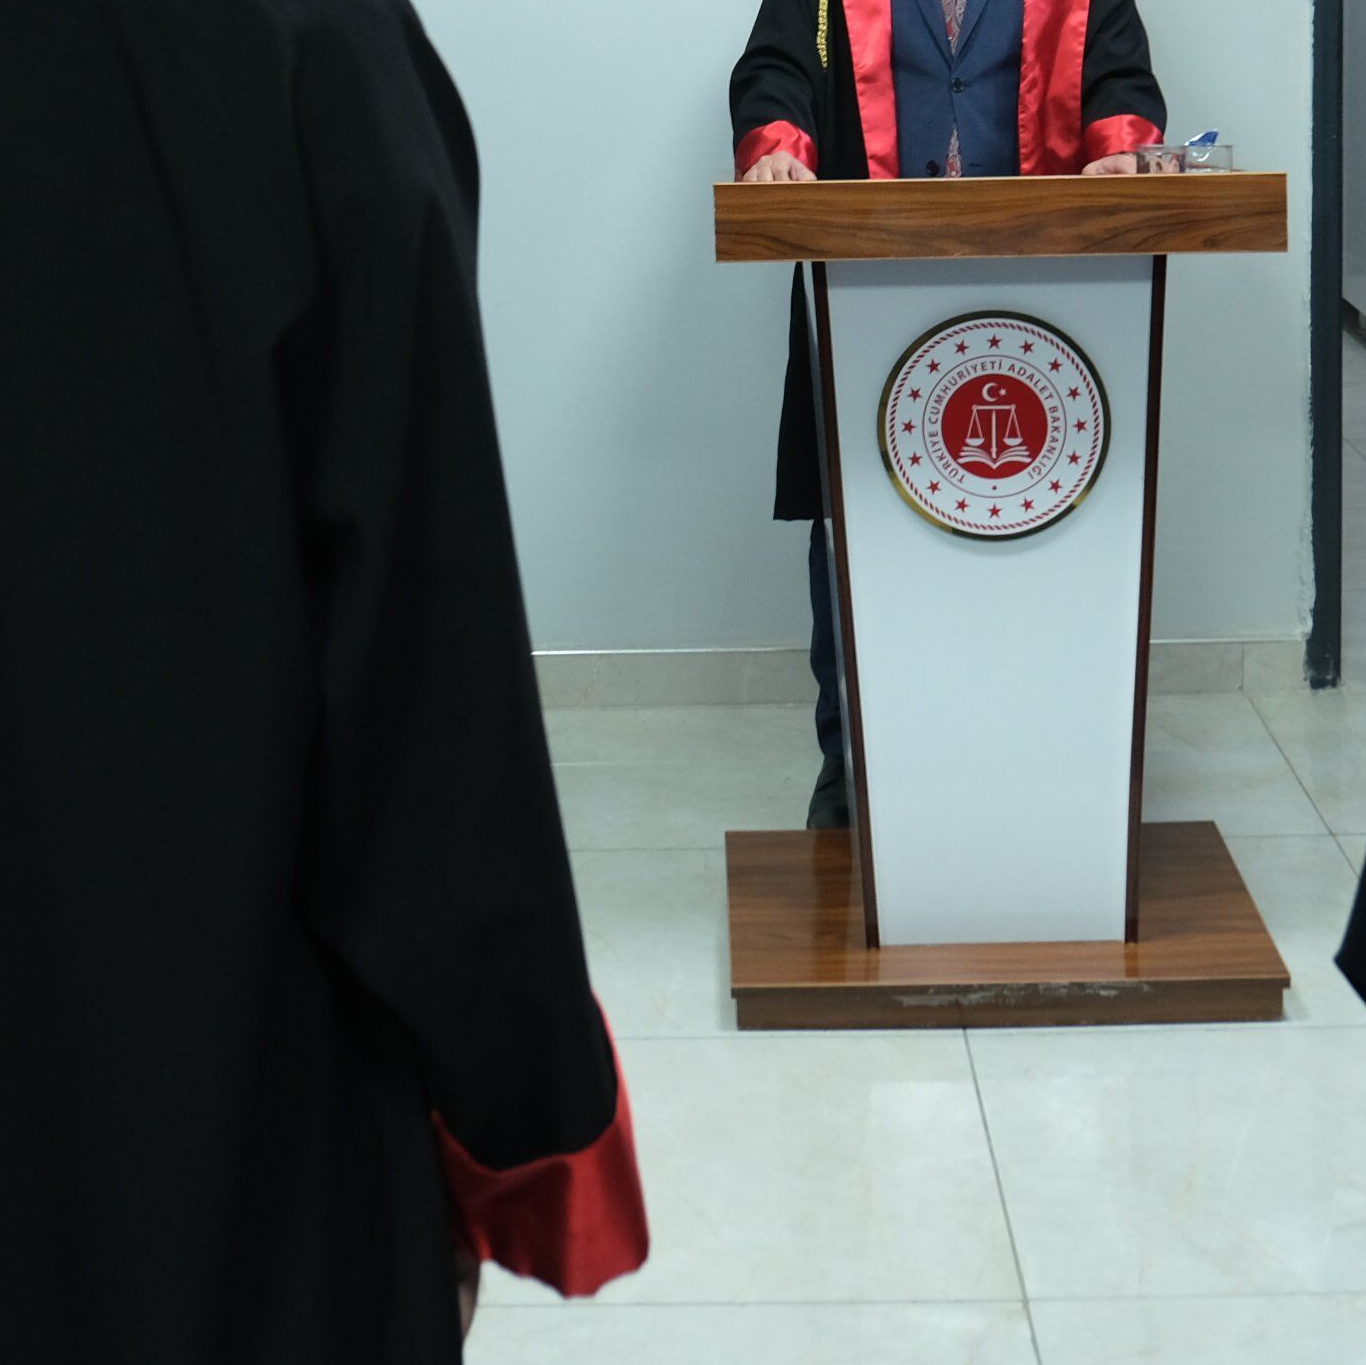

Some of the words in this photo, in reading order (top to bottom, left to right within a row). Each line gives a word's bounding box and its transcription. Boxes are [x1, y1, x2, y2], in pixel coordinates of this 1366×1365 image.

[928, 360, 1003, 425] CUMHURİYETİ
[1007, 362, 1053, 402] ADALET
[928, 429, 966, 484] TÜRKİYE
[1028, 405, 1062, 481] BAKANLIĞI
